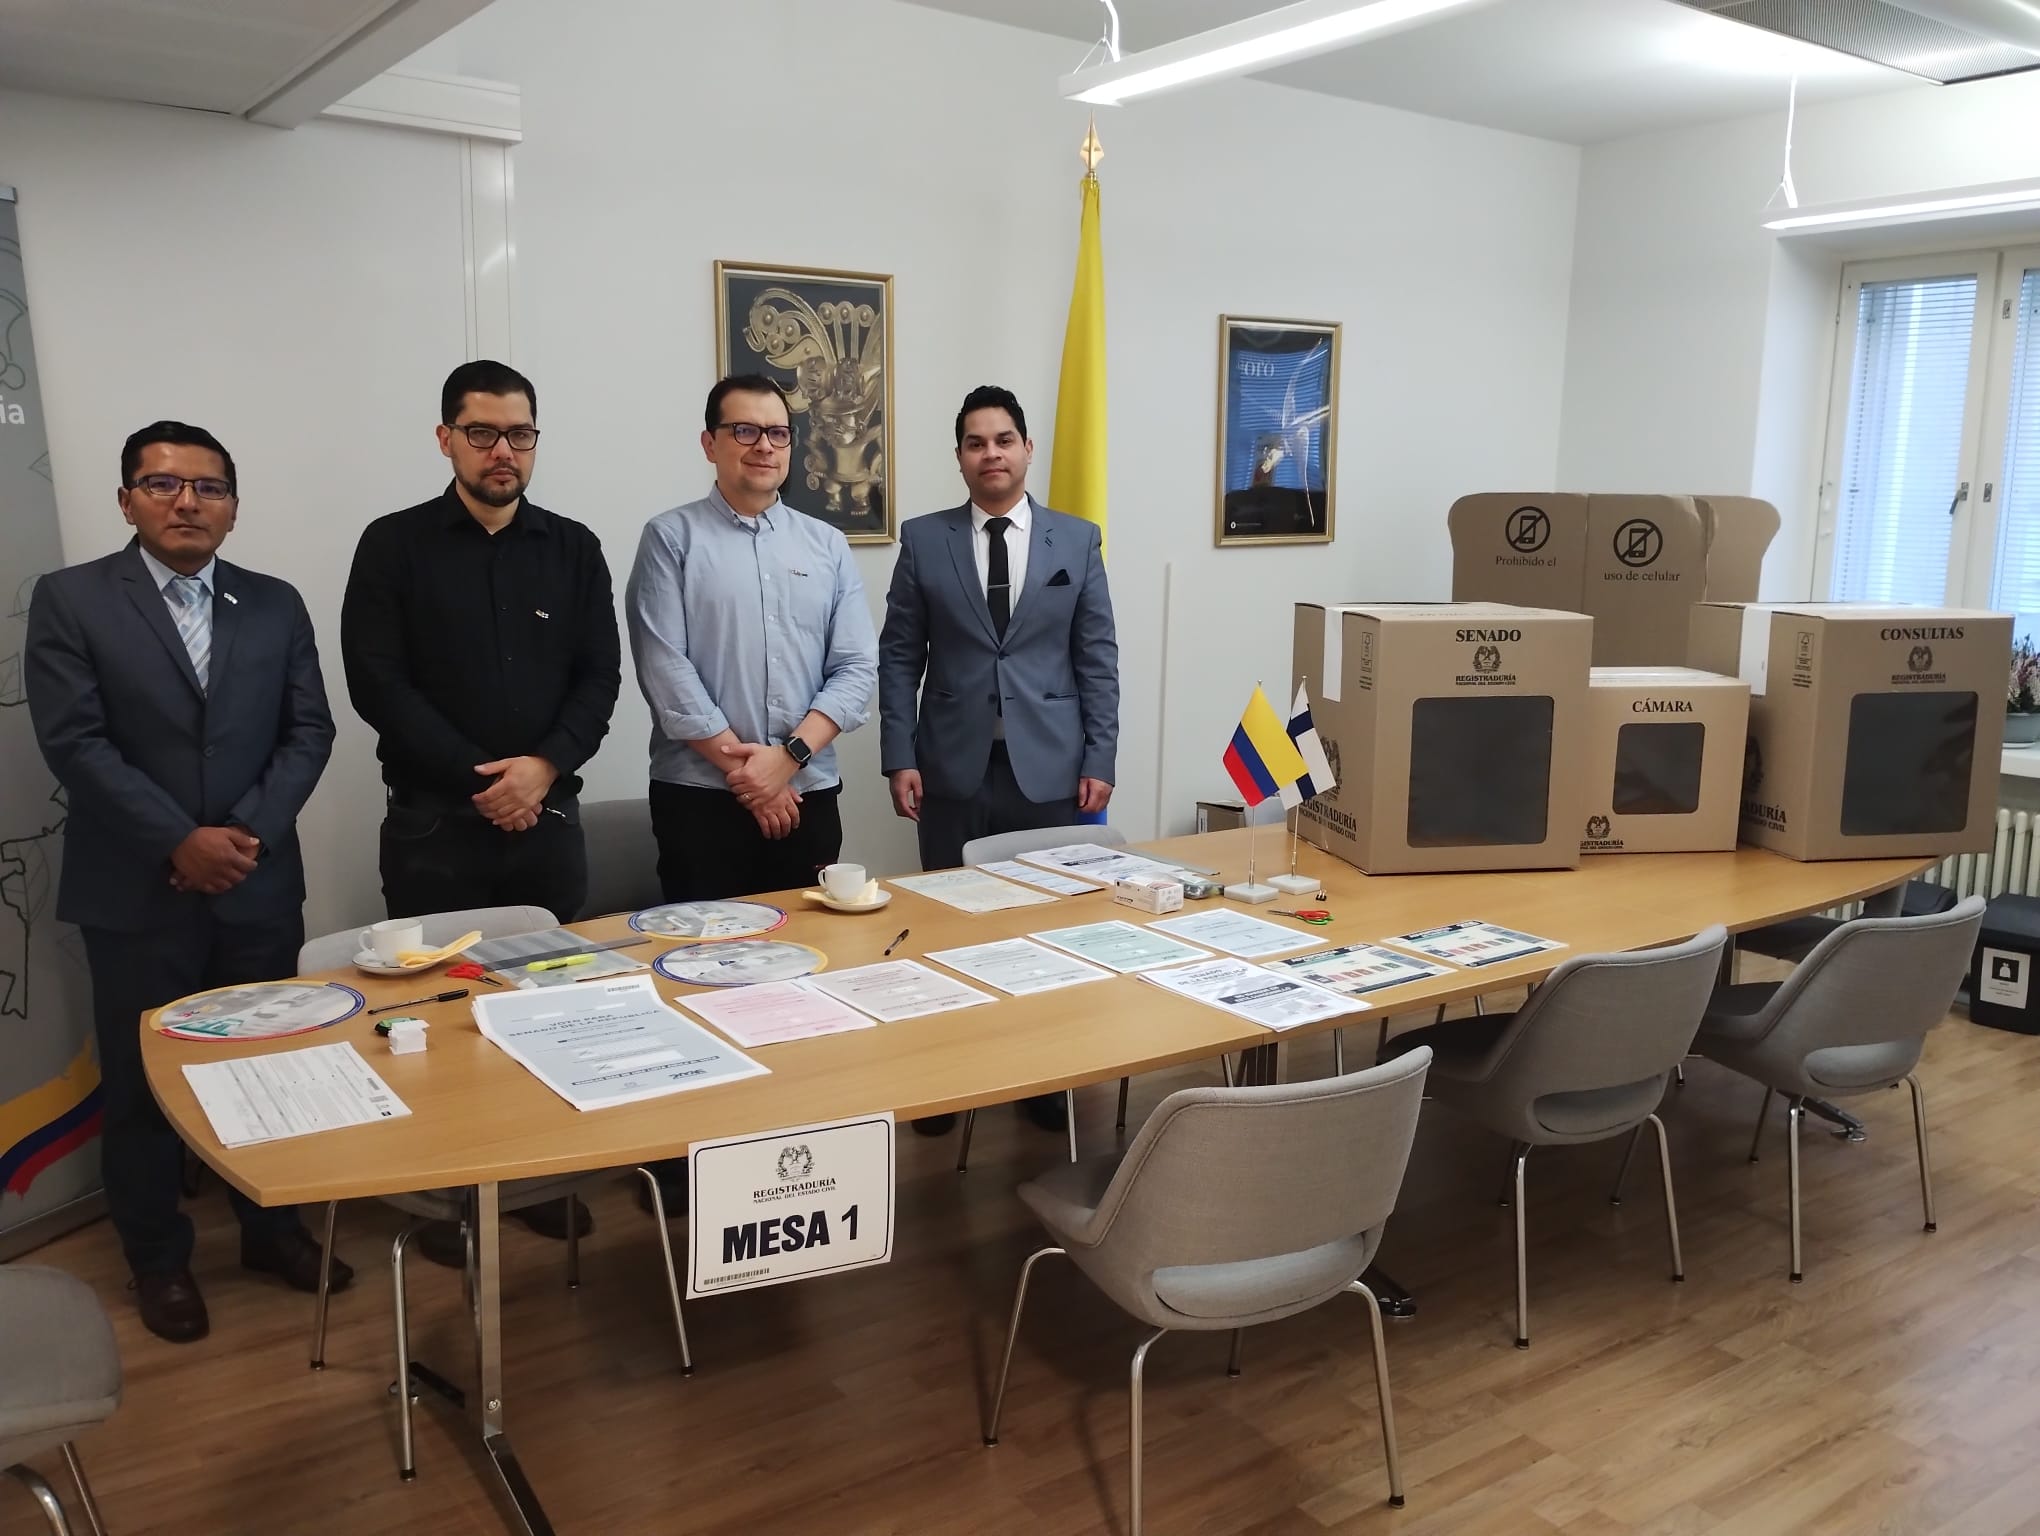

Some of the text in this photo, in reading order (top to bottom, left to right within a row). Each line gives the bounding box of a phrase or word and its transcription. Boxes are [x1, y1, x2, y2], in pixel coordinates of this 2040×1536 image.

[1495, 555, 1557, 567] Prohibido el
[1603, 570, 1681, 582] uso de celular
[1455, 629, 1522, 642] SENADO
[1880, 627, 1965, 641] CONSULTAS
[1631, 698, 1694, 713] CÁMARA
[753, 1176, 837, 1199] REGISTRADURÍA
[753, 1185, 836, 1205] NACIONAL DEL ESTADO CIVIL
[722, 1204, 858, 1265] MESA 1
